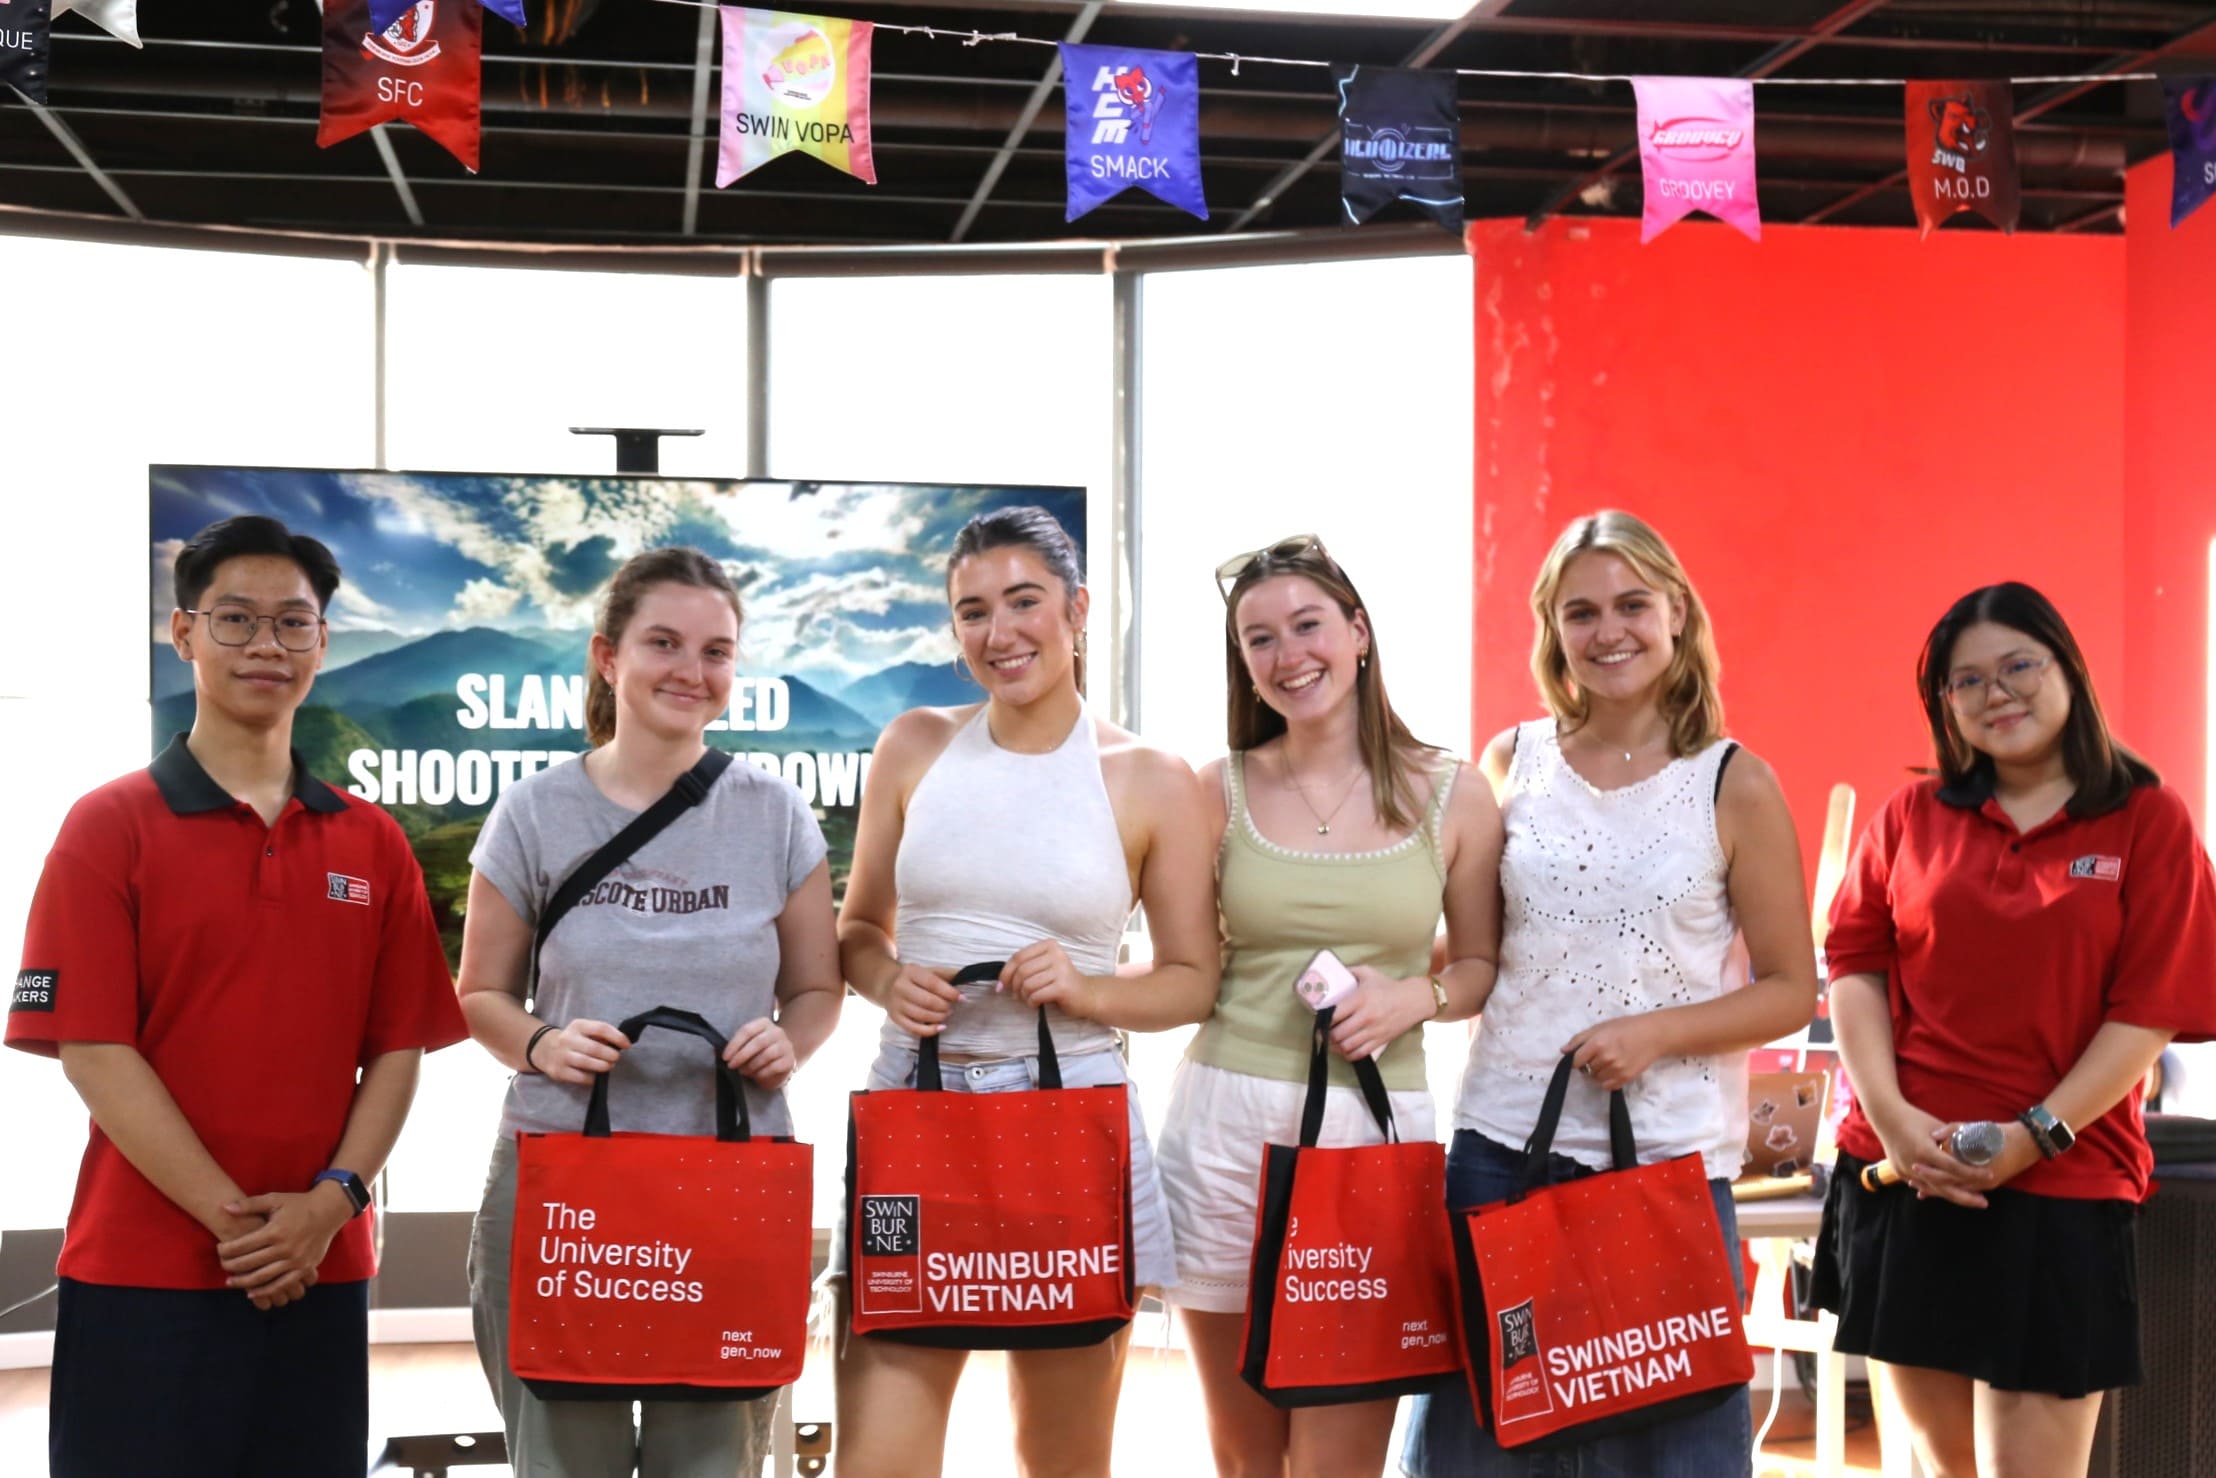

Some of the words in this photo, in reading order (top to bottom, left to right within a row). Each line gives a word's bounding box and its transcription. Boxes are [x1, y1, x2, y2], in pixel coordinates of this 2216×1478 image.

[377, 76, 424, 107] SFC
[736, 112, 790, 140] SWIN
[795, 120, 855, 144] VOPA
[1091, 154, 1171, 179] SMACK
[1659, 178, 1736, 201] GROOVEY
[1934, 176, 1990, 200] M.O.D
[456, 673, 583, 730] SLAN
[576, 881, 647, 912] SCOTE
[651, 885, 729, 914] URBAN
[15, 975, 52, 989] ANGE
[13, 990, 49, 1003] KERS
[543, 1202, 596, 1230] The
[871, 1218, 908, 1235] BUR
[540, 1236, 692, 1275] University
[876, 1235, 904, 1252] NE
[927, 1244, 1120, 1281] SWINBURNE
[1287, 1242, 1372, 1274] iversity
[536, 1270, 567, 1298] of
[573, 1270, 703, 1303] Success
[927, 1282, 1074, 1313] VIETNAM
[1285, 1275, 1388, 1303] Success
[722, 1330, 753, 1343] next
[1402, 1319, 1428, 1332] next
[720, 1345, 782, 1361] gen_now
[1547, 1306, 1732, 1377] SWINBURNE
[1554, 1349, 1692, 1409] VIETNAM
